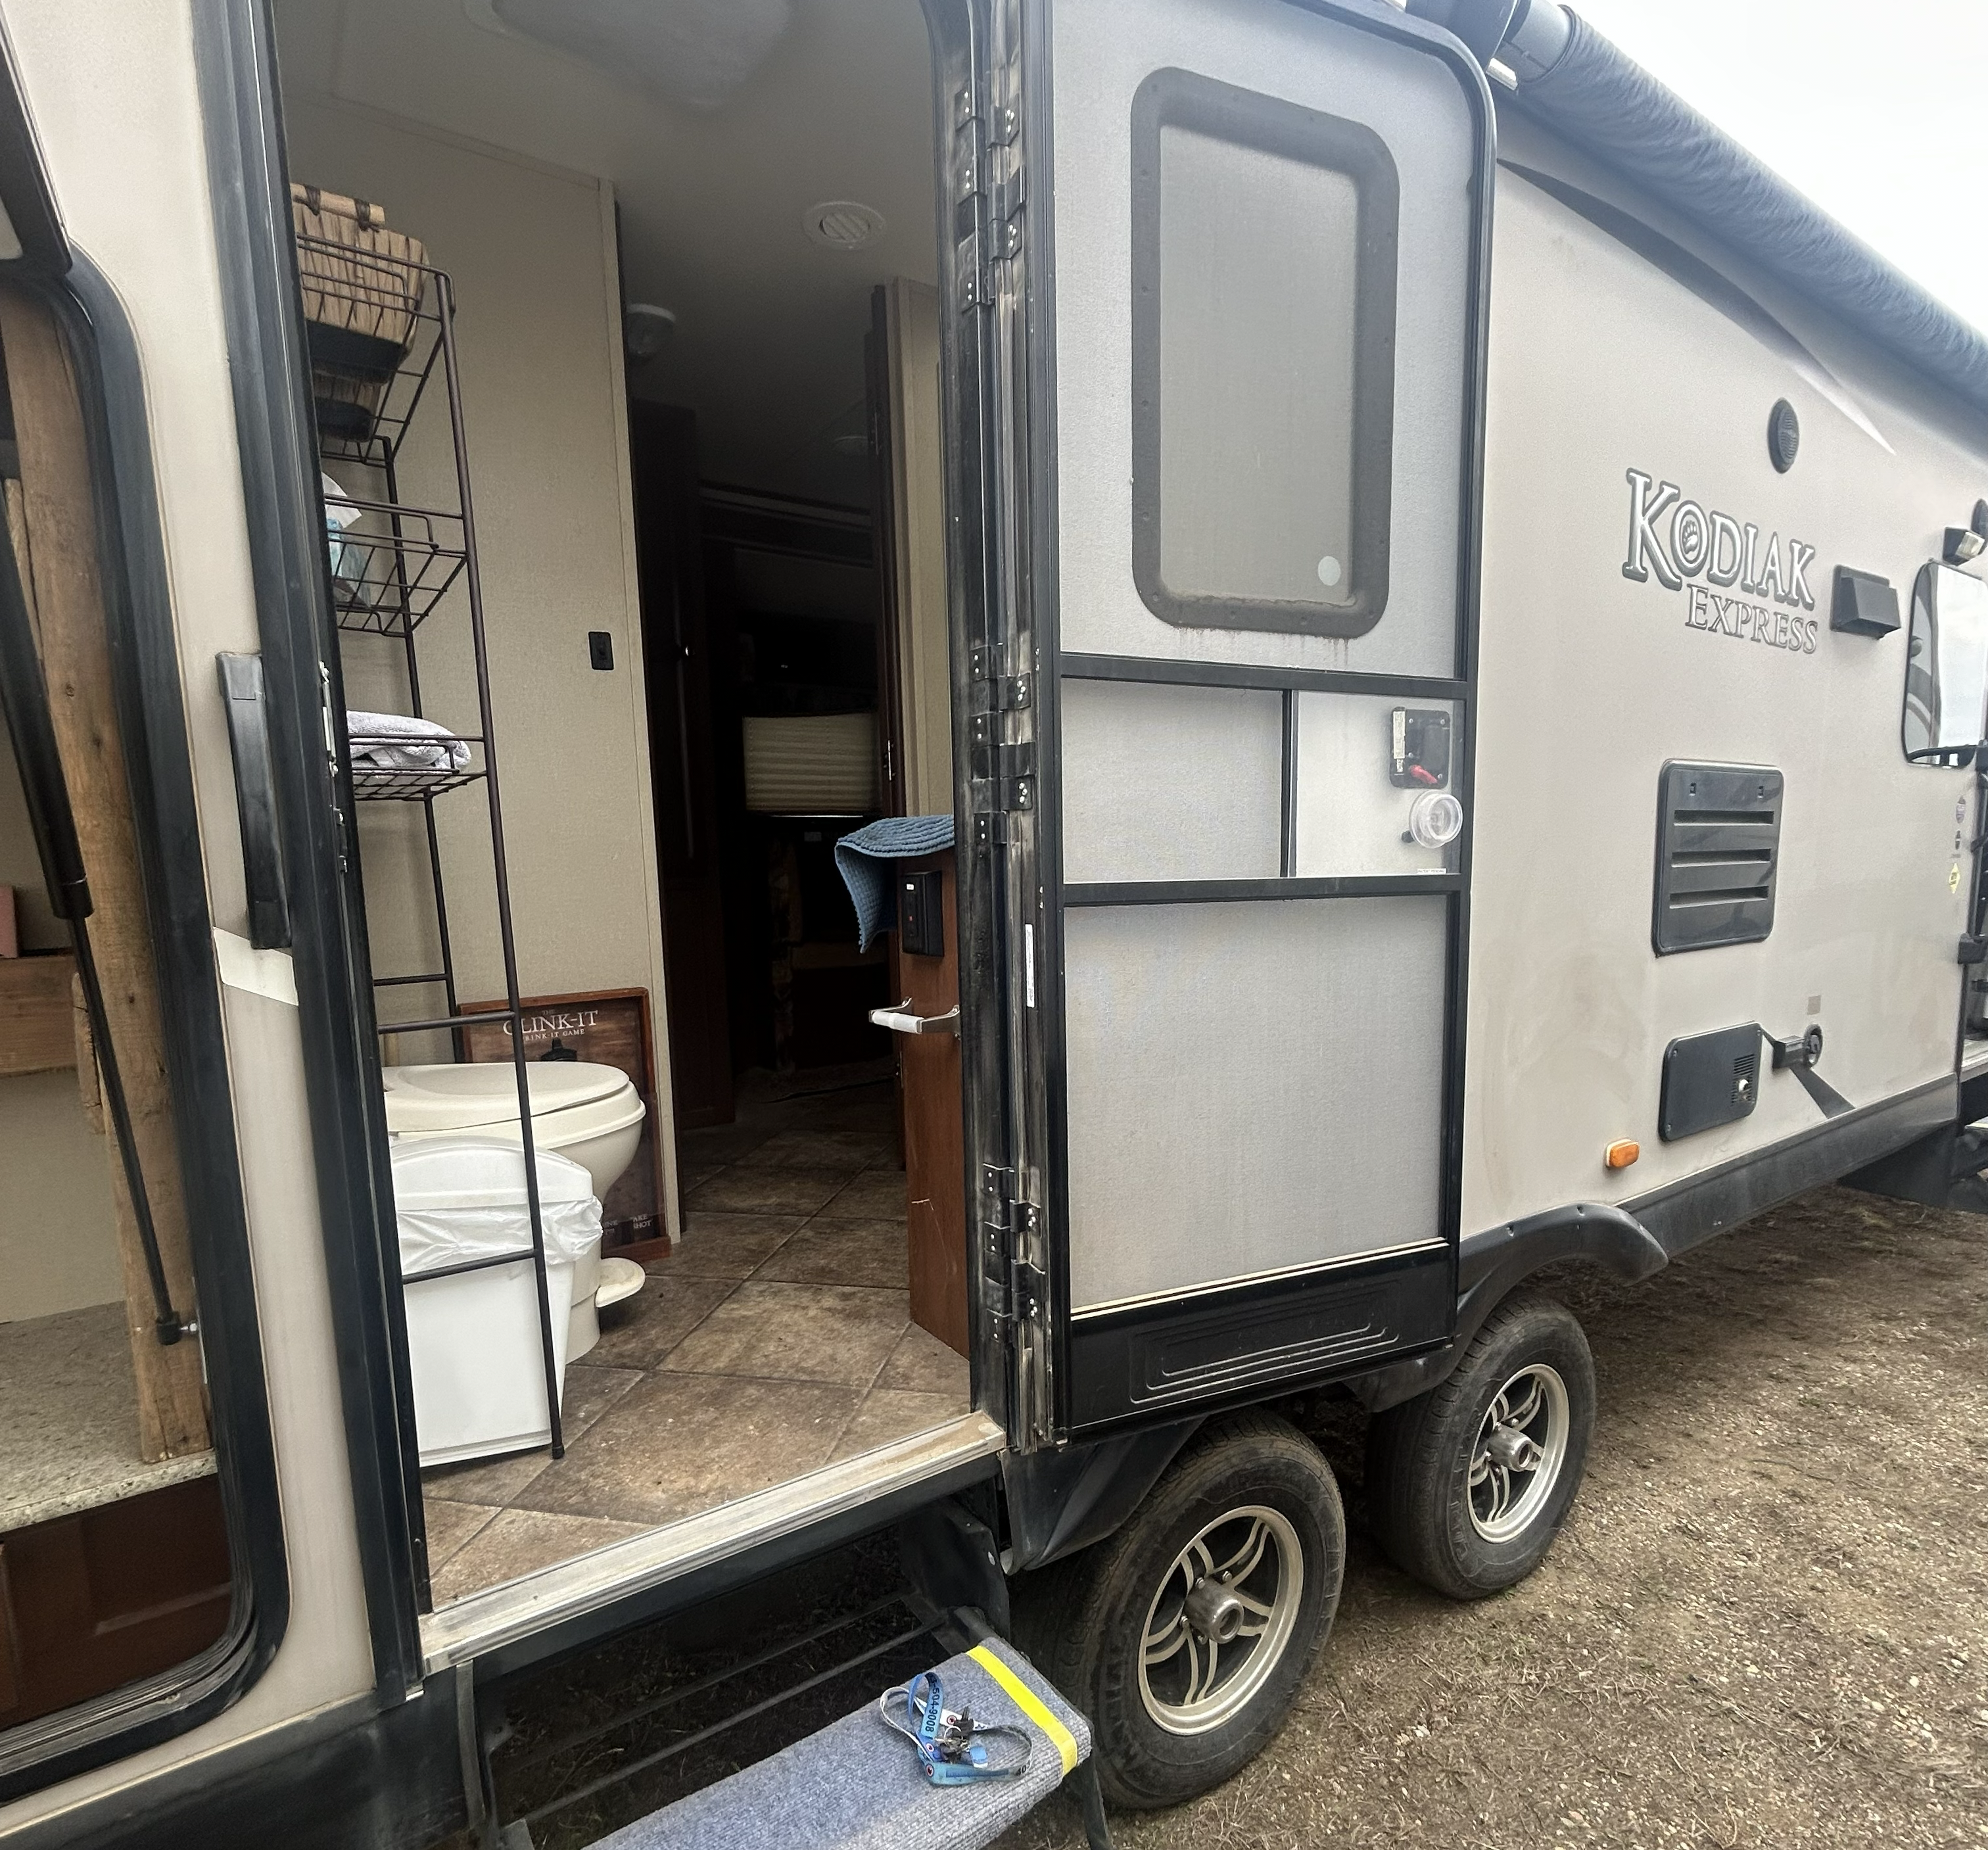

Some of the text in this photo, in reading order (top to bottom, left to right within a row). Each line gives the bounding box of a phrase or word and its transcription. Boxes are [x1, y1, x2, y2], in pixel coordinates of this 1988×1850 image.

[1622, 467, 1815, 611] KODIAK
[1685, 583, 1818, 654] EXPRESS
[523, 1028, 585, 1041] RINK-IT GAME
